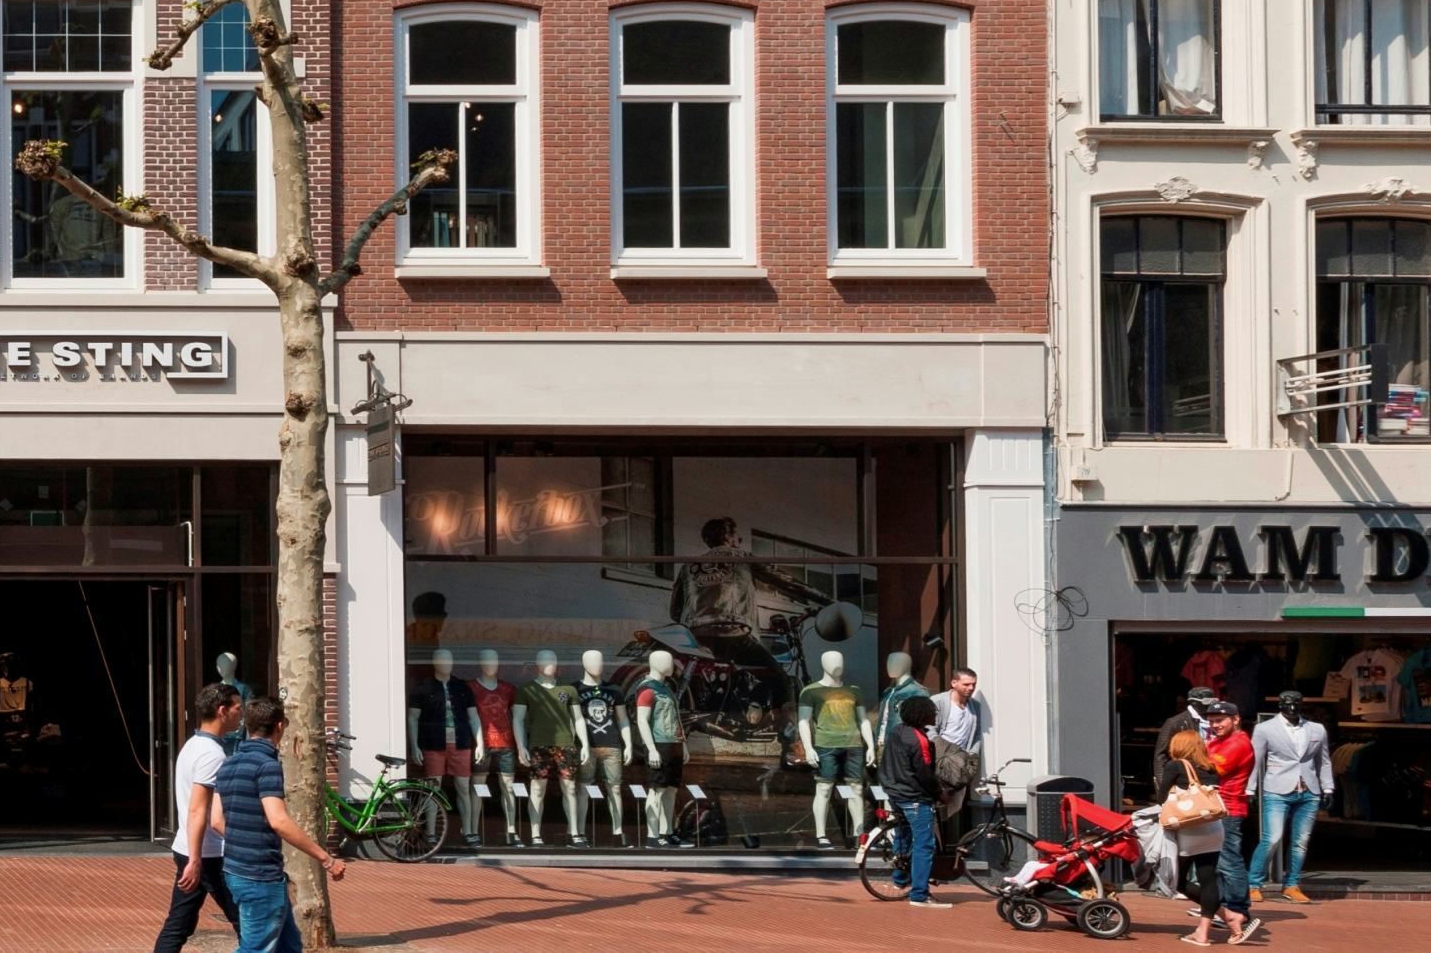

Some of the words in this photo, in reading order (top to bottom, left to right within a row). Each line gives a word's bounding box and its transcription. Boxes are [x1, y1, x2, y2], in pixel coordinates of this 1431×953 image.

[52, 341, 213, 367] STING
[1115, 525, 1342, 583] WAM
[1365, 527, 1431, 583] D
